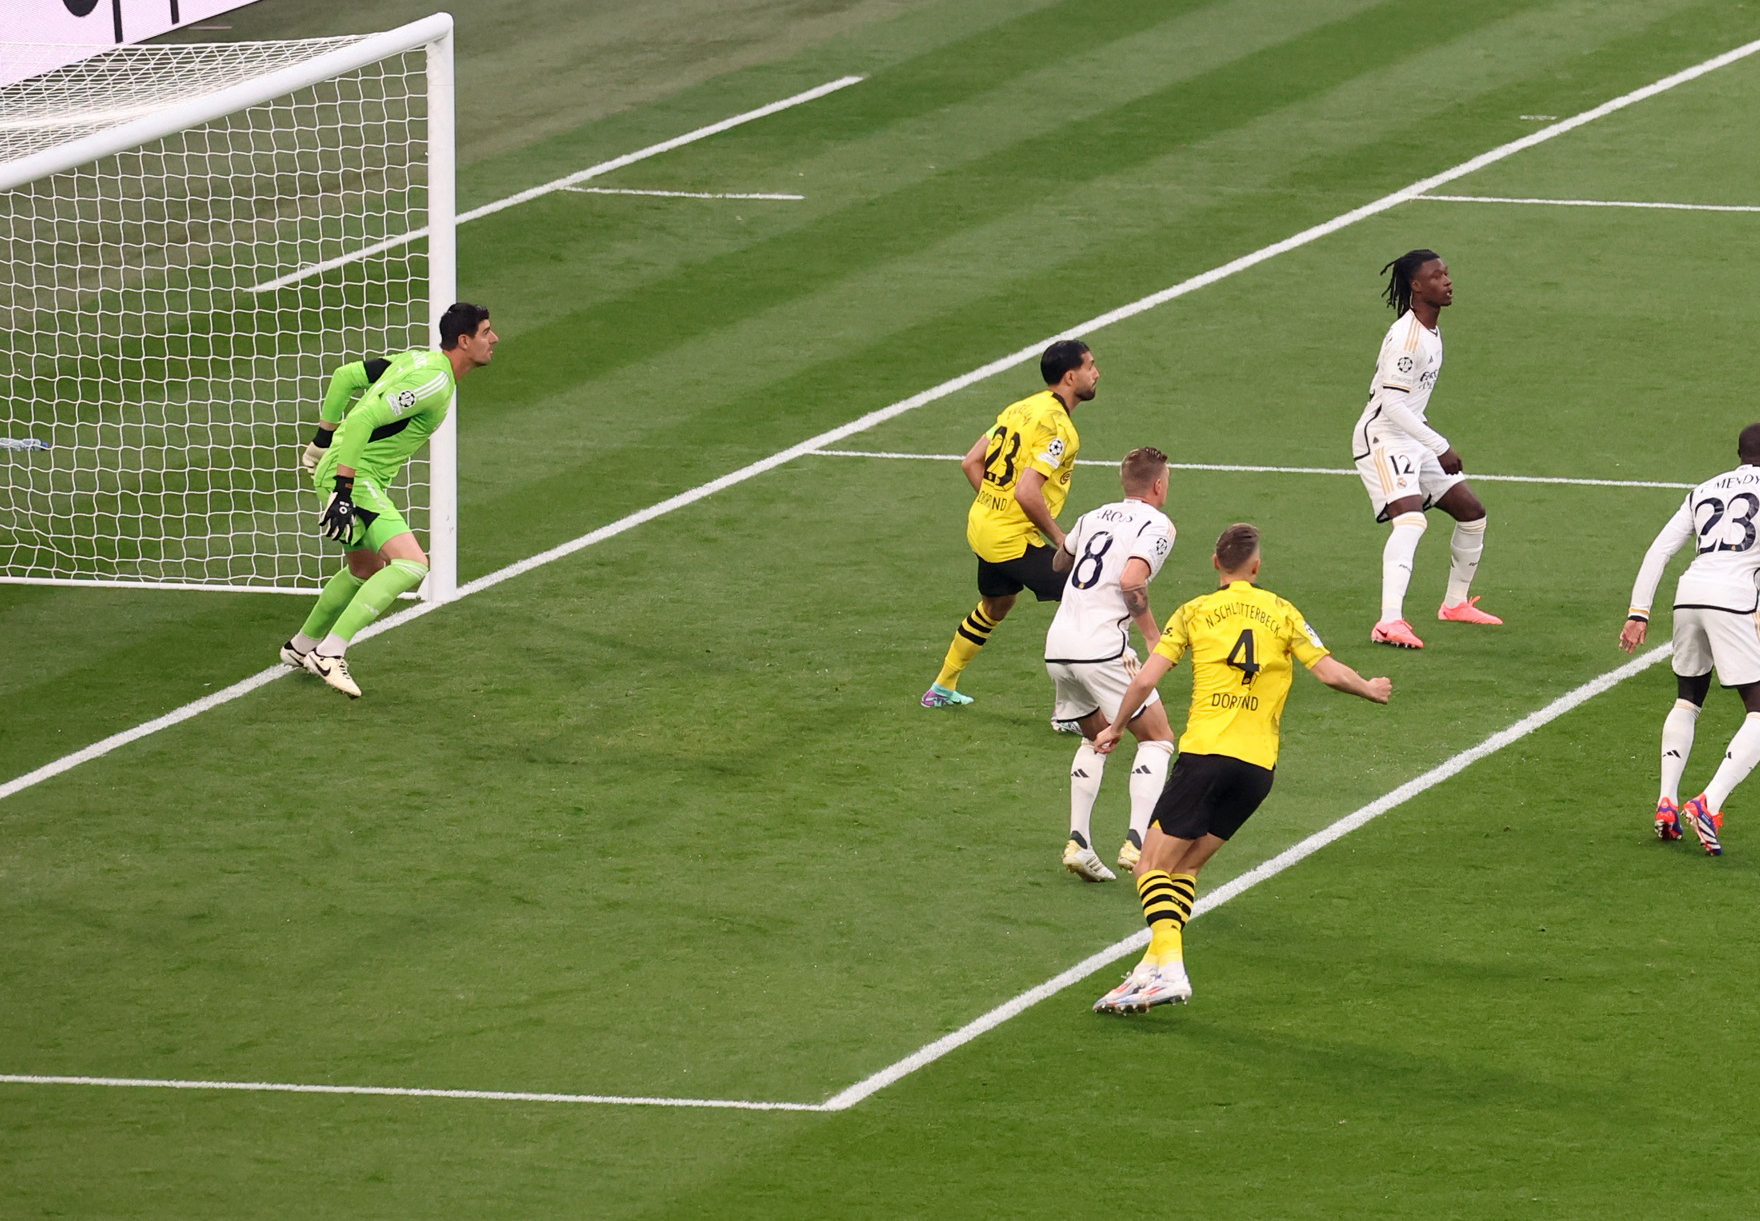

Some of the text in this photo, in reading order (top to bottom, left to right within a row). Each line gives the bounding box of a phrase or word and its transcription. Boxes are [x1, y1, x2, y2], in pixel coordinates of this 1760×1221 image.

[984, 425, 1020, 489] 23
[1389, 454, 1415, 476] 12
[1695, 492, 1760, 554] 23
[1072, 530, 1114, 591] 8
[1226, 628, 1261, 688] 4
